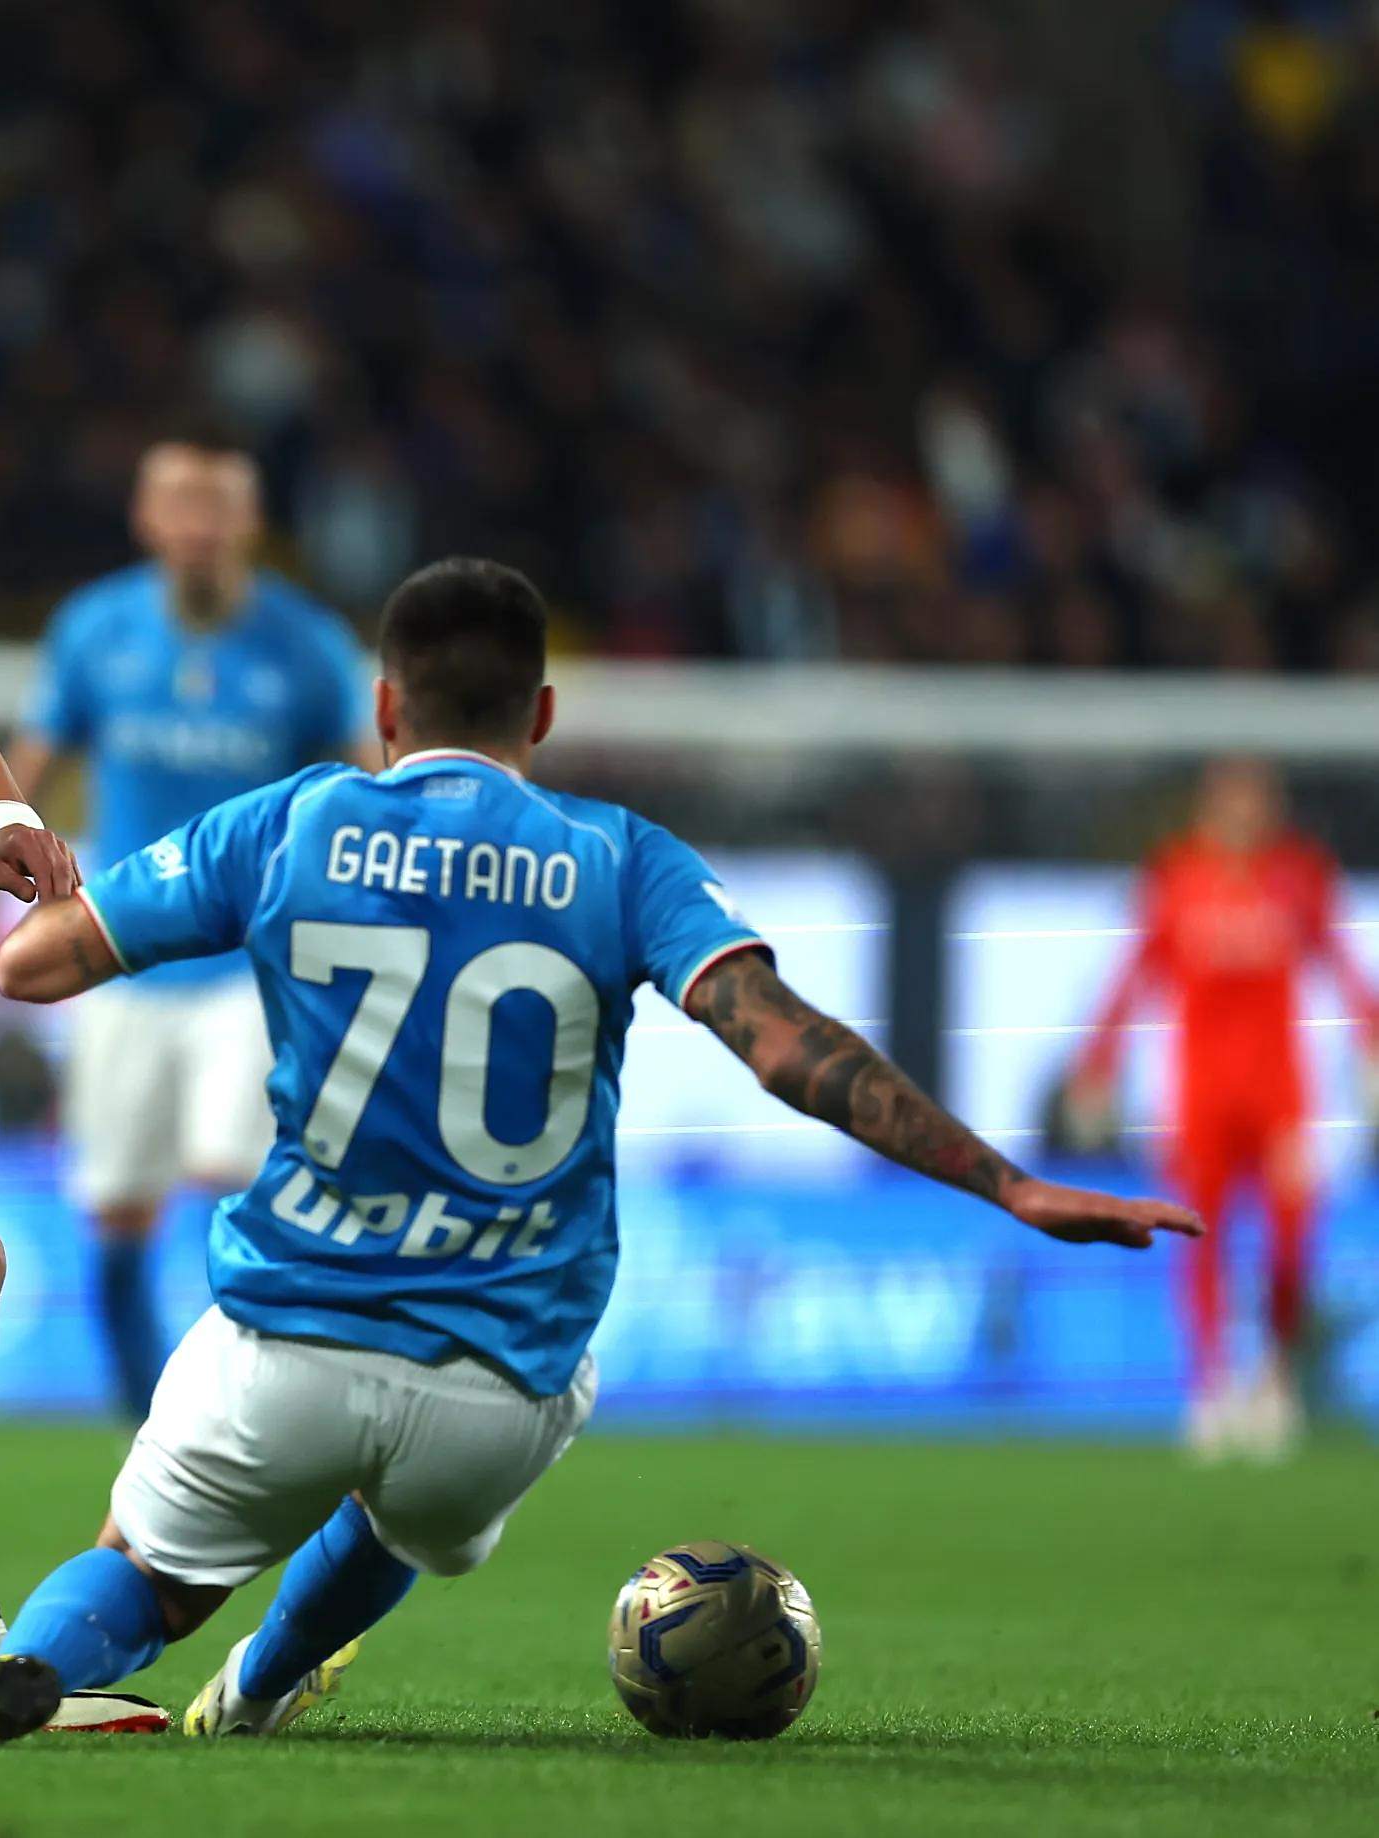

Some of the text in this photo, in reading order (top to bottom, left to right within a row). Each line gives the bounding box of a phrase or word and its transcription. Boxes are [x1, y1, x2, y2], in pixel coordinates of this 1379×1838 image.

[326, 825, 579, 911] GAETANO
[290, 919, 600, 1187] 70
[270, 1165, 558, 1261] upbit
